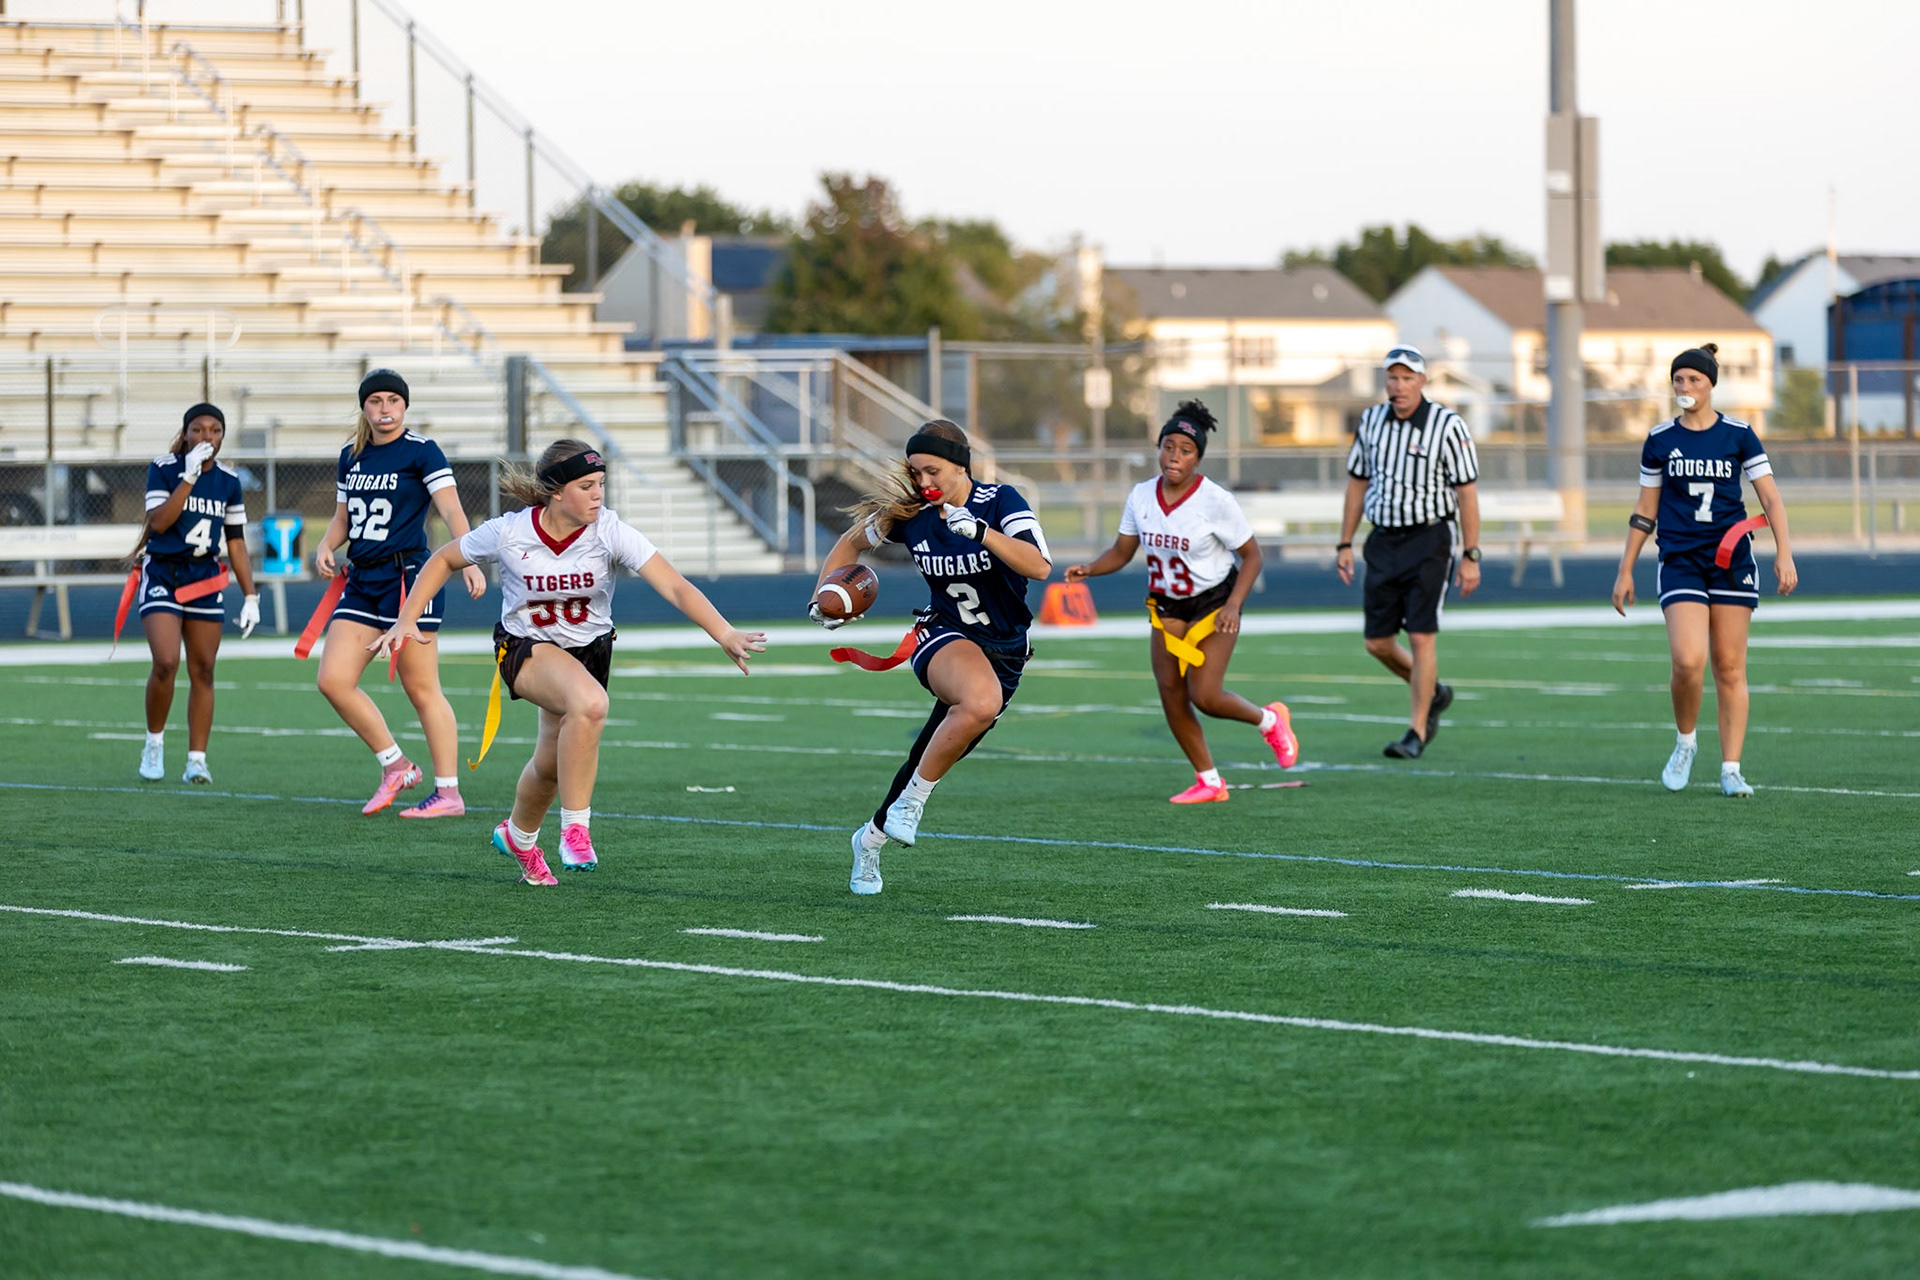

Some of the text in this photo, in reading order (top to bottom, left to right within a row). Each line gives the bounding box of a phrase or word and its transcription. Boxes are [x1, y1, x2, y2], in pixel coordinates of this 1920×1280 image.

[346, 473, 398, 490] COUGARS
[1668, 458, 1732, 478] COUGARS
[1688, 482, 1714, 522] 7
[348, 497, 393, 541] 22
[185, 518, 212, 557] 4
[1142, 532, 1190, 552] TIGERS
[914, 550, 992, 576] COUGARS
[1147, 555, 1194, 596] 23
[523, 572, 594, 592] TIGERS
[946, 583, 991, 625] 2
